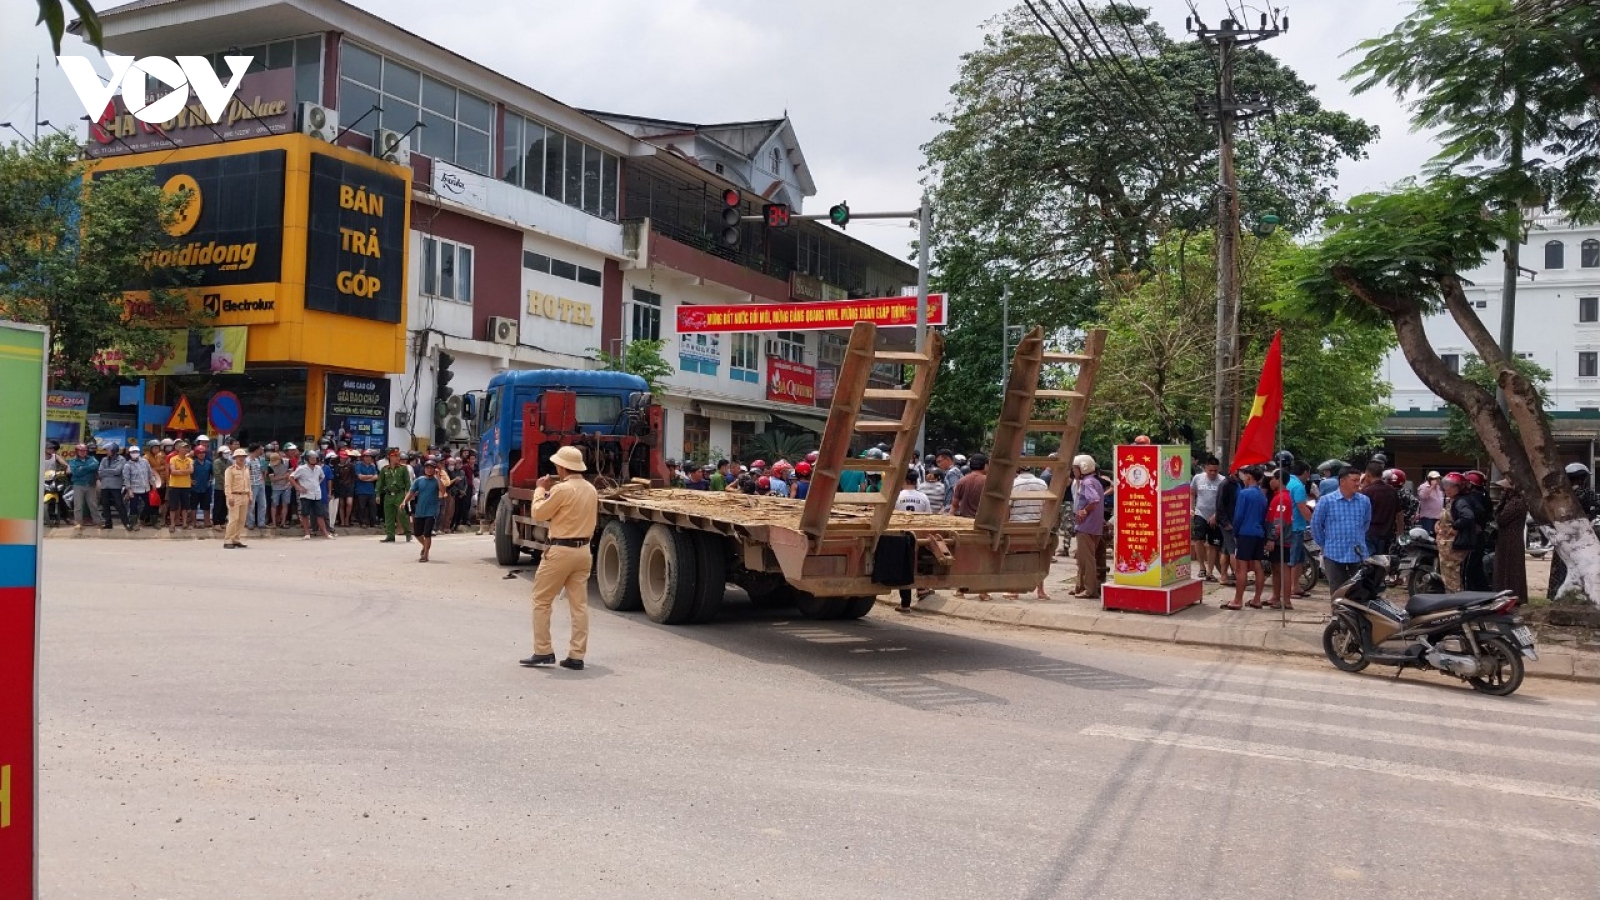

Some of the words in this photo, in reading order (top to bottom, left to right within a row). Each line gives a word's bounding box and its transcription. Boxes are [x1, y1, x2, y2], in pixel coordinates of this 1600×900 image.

[339, 184, 384, 218] BÁN
[768, 205, 789, 227] 34
[339, 226, 382, 260] TRẢ
[336, 267, 382, 300] GÓP
[222, 299, 275, 312] Electrolux
[527, 289, 594, 328] HOTEL
[805, 307, 825, 323] QUANG
